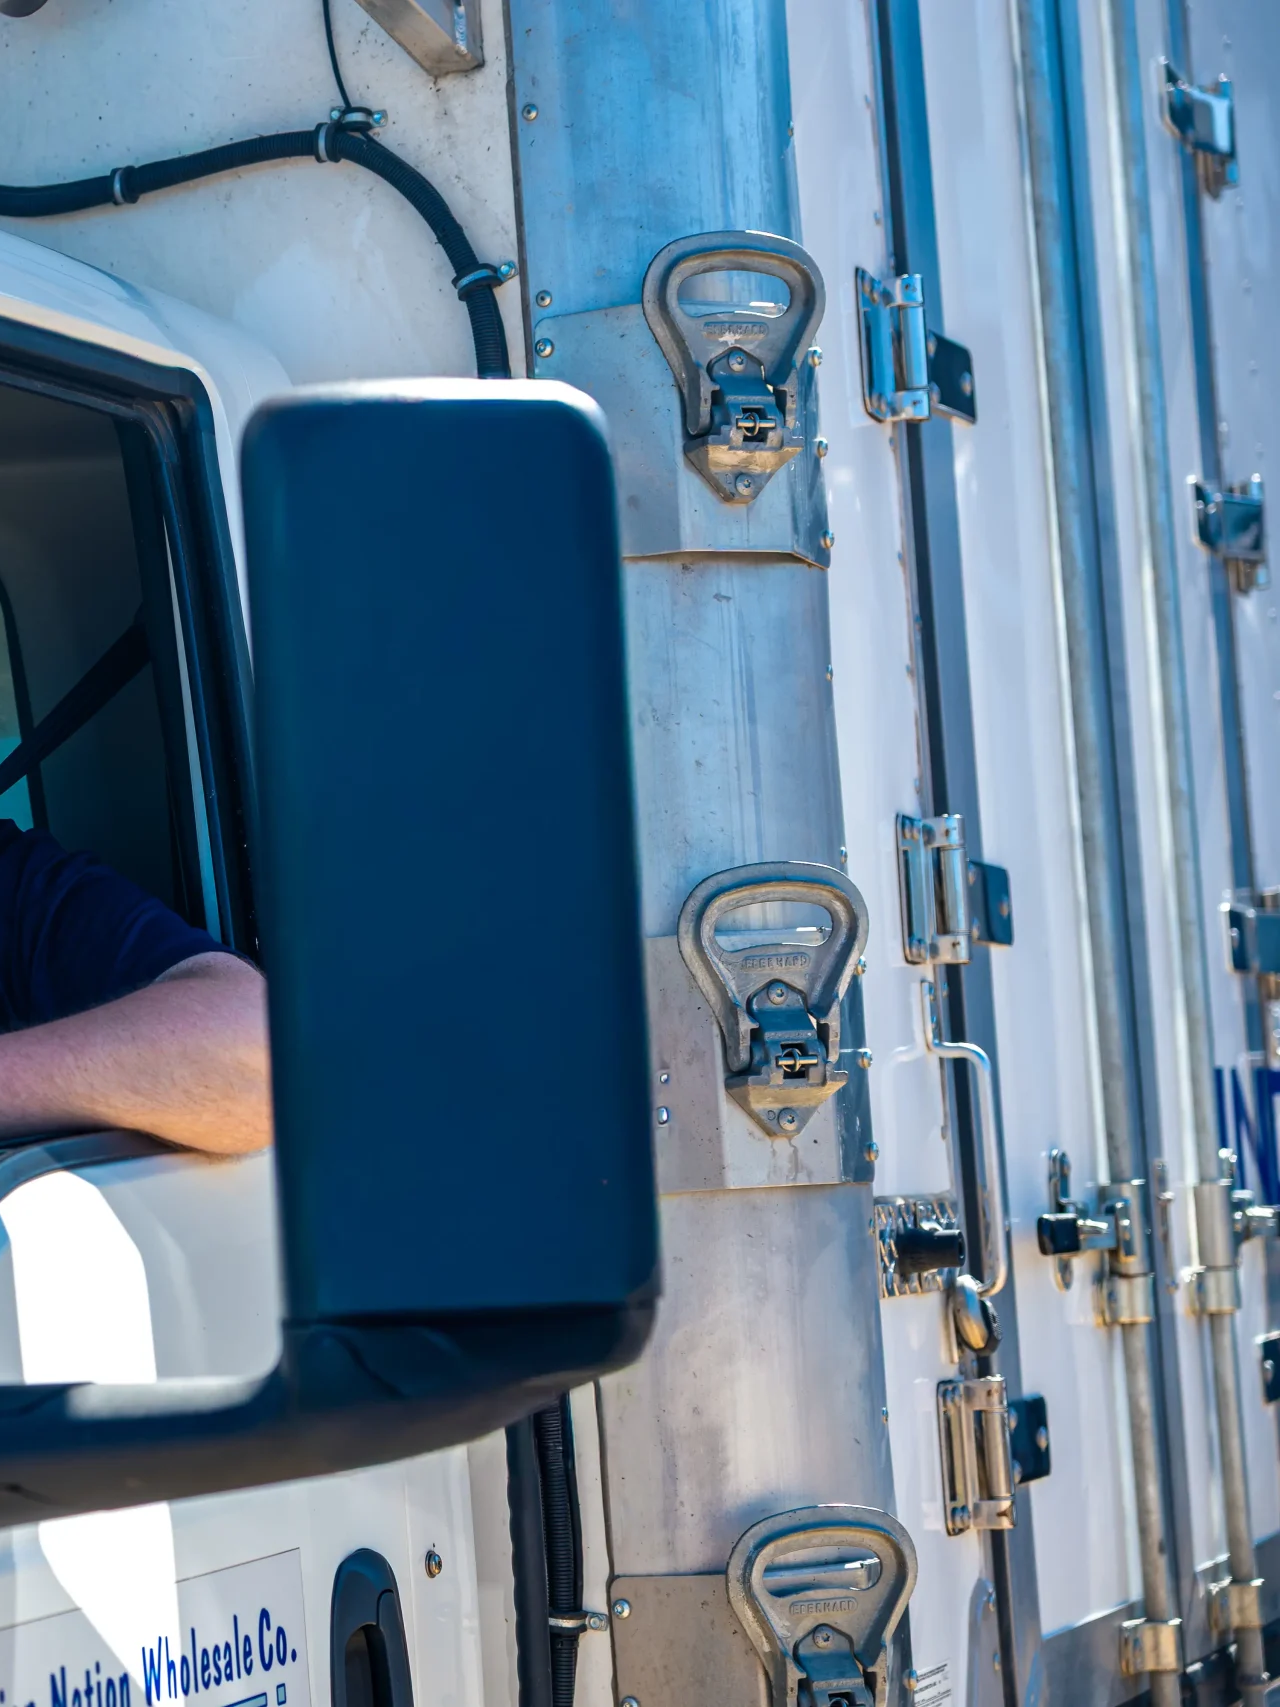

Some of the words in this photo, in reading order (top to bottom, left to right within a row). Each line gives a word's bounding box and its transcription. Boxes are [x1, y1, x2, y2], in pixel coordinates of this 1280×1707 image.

[49, 1660, 131, 1707] Nation
[141, 1613, 254, 1707] Wholesale
[258, 1607, 297, 1672] Co.
